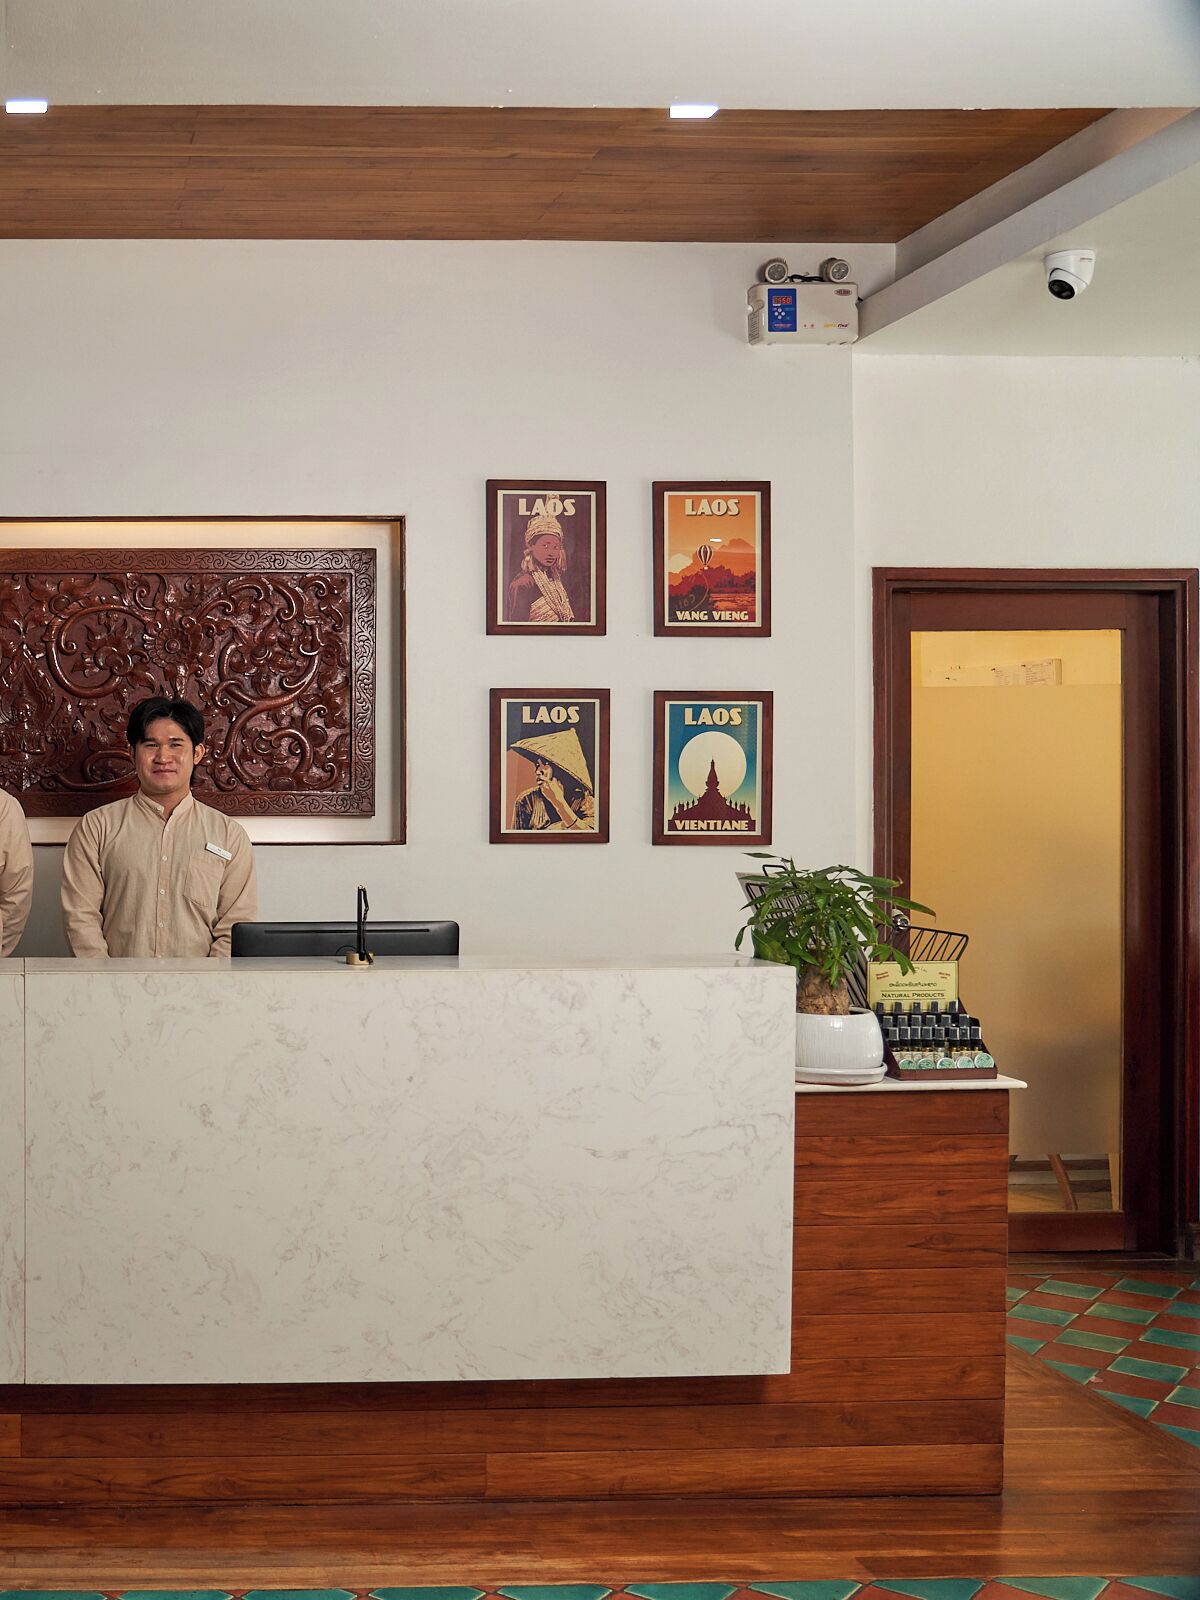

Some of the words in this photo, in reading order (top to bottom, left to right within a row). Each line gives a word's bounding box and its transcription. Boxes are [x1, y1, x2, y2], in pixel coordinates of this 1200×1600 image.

[518, 498, 576, 516] LAOS
[684, 498, 740, 516] LAOS
[676, 610, 708, 621] VANG
[712, 610, 749, 621] VIENG
[522, 705, 580, 724] LAOS
[684, 707, 742, 726] LAOS
[674, 820, 749, 831] VIENTIANE
